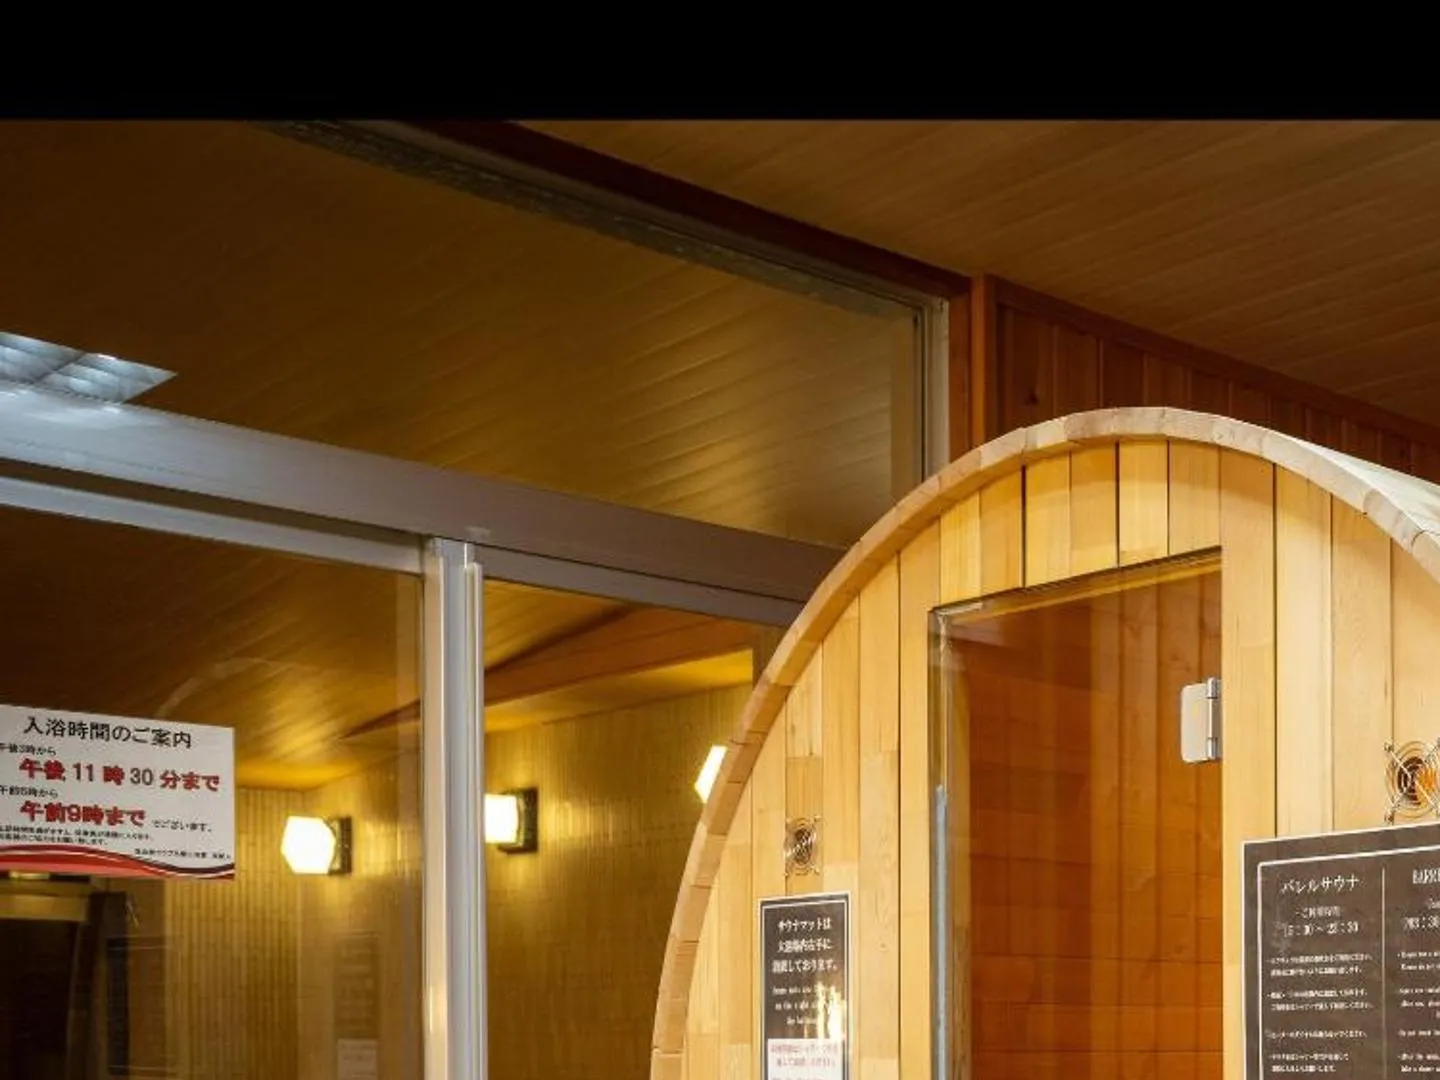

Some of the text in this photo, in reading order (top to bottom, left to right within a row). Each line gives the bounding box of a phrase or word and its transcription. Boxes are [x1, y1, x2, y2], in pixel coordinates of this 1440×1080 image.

[23, 716, 192, 749] 入浴時間のご案内
[19, 757, 66, 782] 午後
[72, 762, 95, 782] 11
[129, 768, 153, 786] 30
[160, 769, 220, 792] 分まで
[20, 800, 146, 827] 午前9時まで
